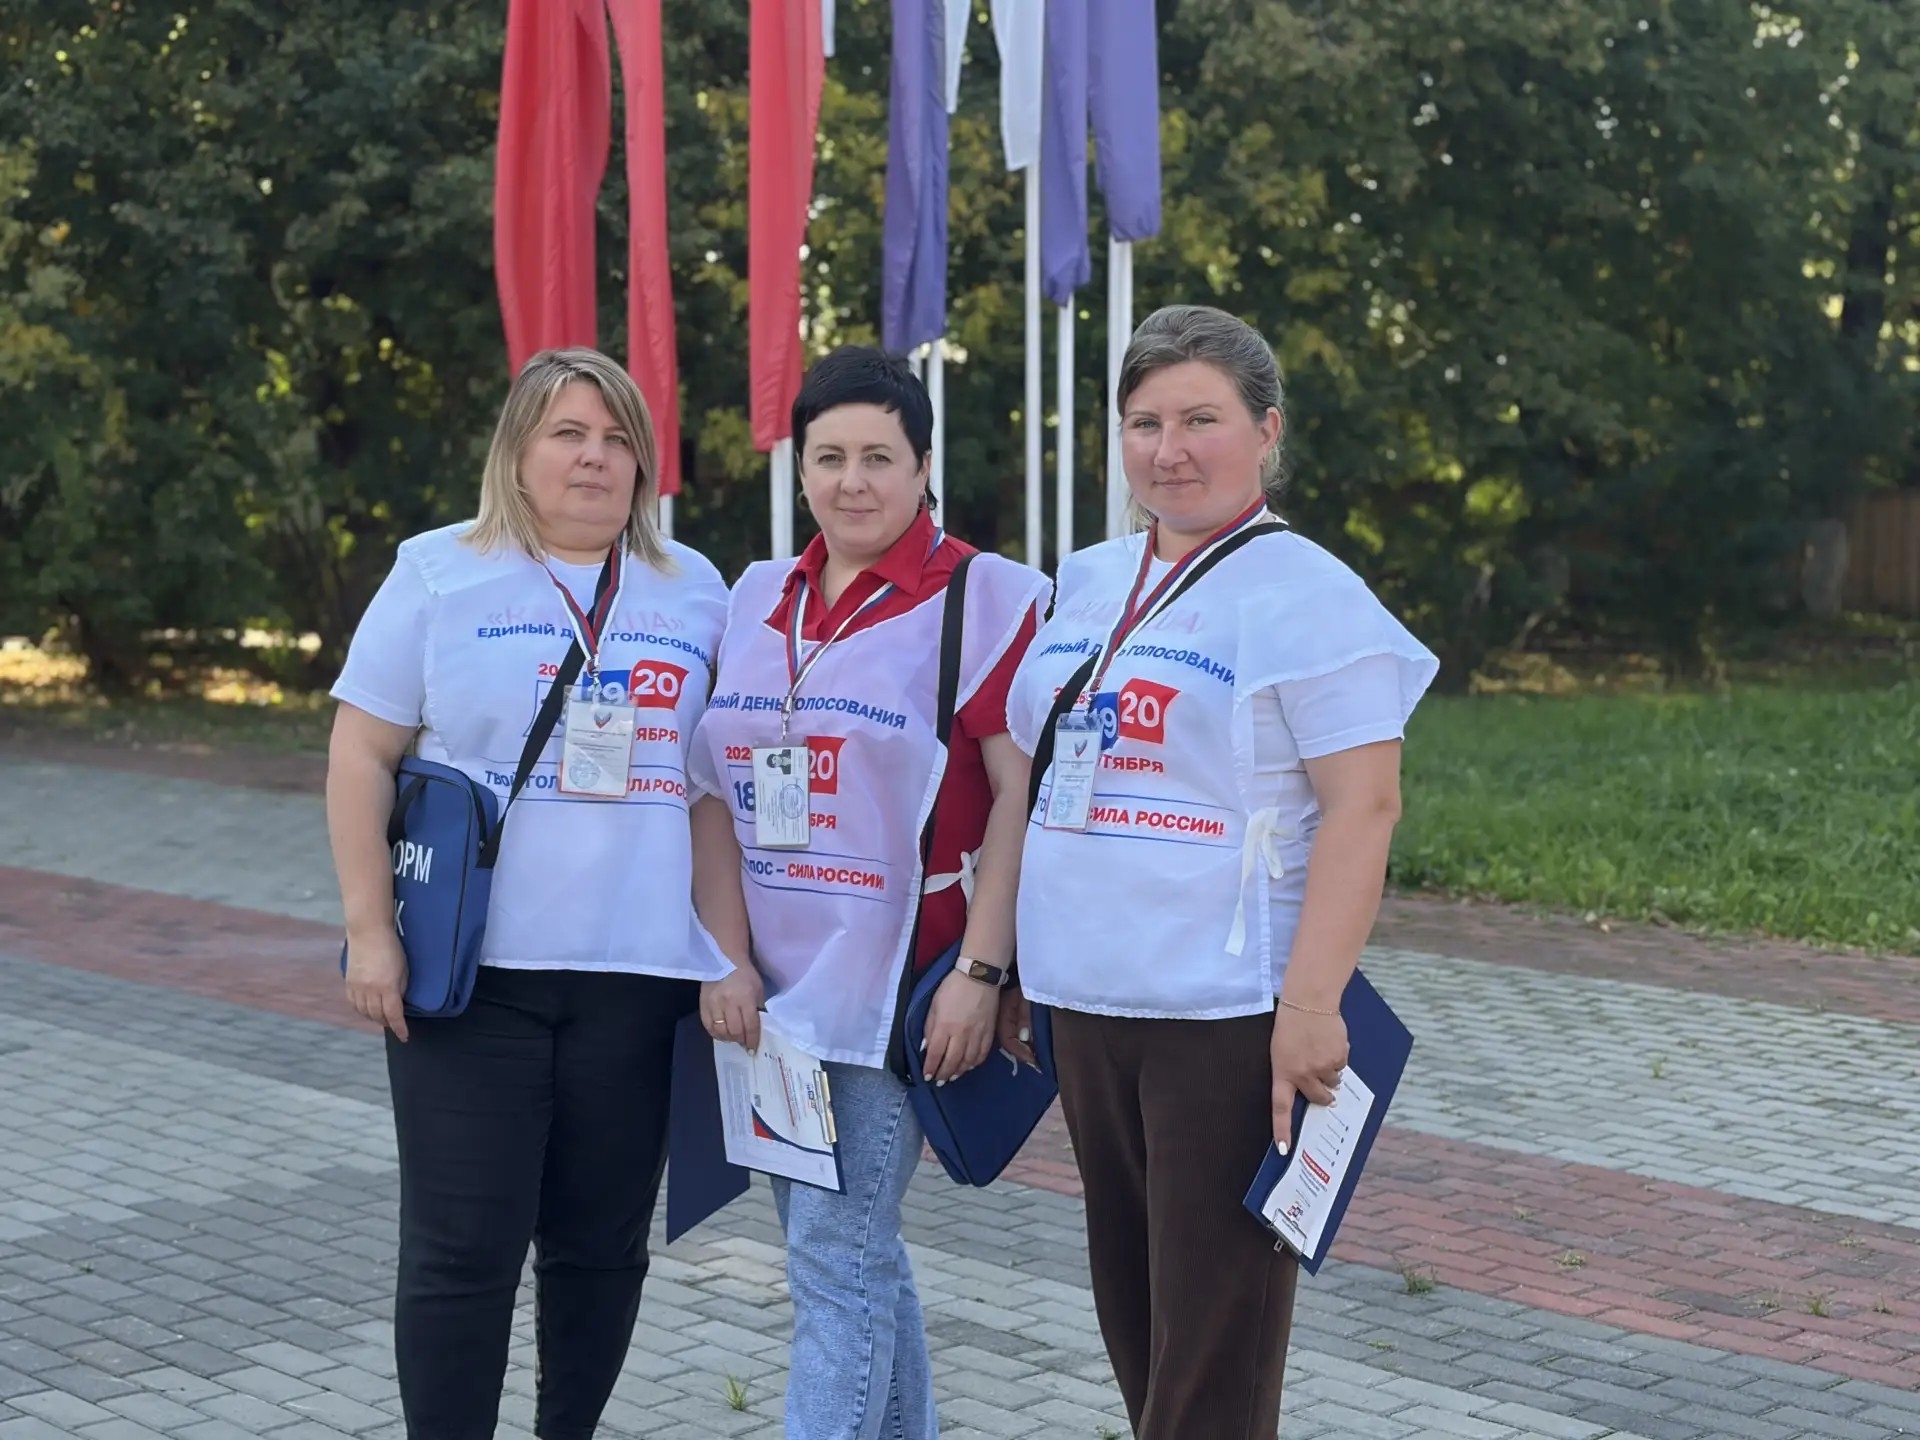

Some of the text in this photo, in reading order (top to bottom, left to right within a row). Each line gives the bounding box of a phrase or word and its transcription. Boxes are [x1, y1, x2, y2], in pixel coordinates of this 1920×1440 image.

[477, 622, 556, 639] ЕДИНЫЙ
[610, 632, 712, 669] ГОЛОСОВАНИ
[538, 663, 558, 676] 20
[1126, 645, 1236, 687] ГОЛОСОВАНИ
[634, 668, 679, 697] 20
[741, 696, 784, 712] ДЕНЬ
[795, 697, 907, 729] ОЛОСОВАНИЯ
[1120, 691, 1160, 728] 20
[635, 727, 679, 744] ЯБРЯ
[725, 746, 751, 761] 202
[1099, 754, 1164, 773] ТЯБРЯ
[525, 774, 557, 789] ГОЛ
[1089, 807, 1225, 836] ИЛА РОССИИ!
[393, 840, 434, 884] ОРМ
[787, 863, 816, 880] СИЛА
[816, 866, 886, 890] РОССИИ!
